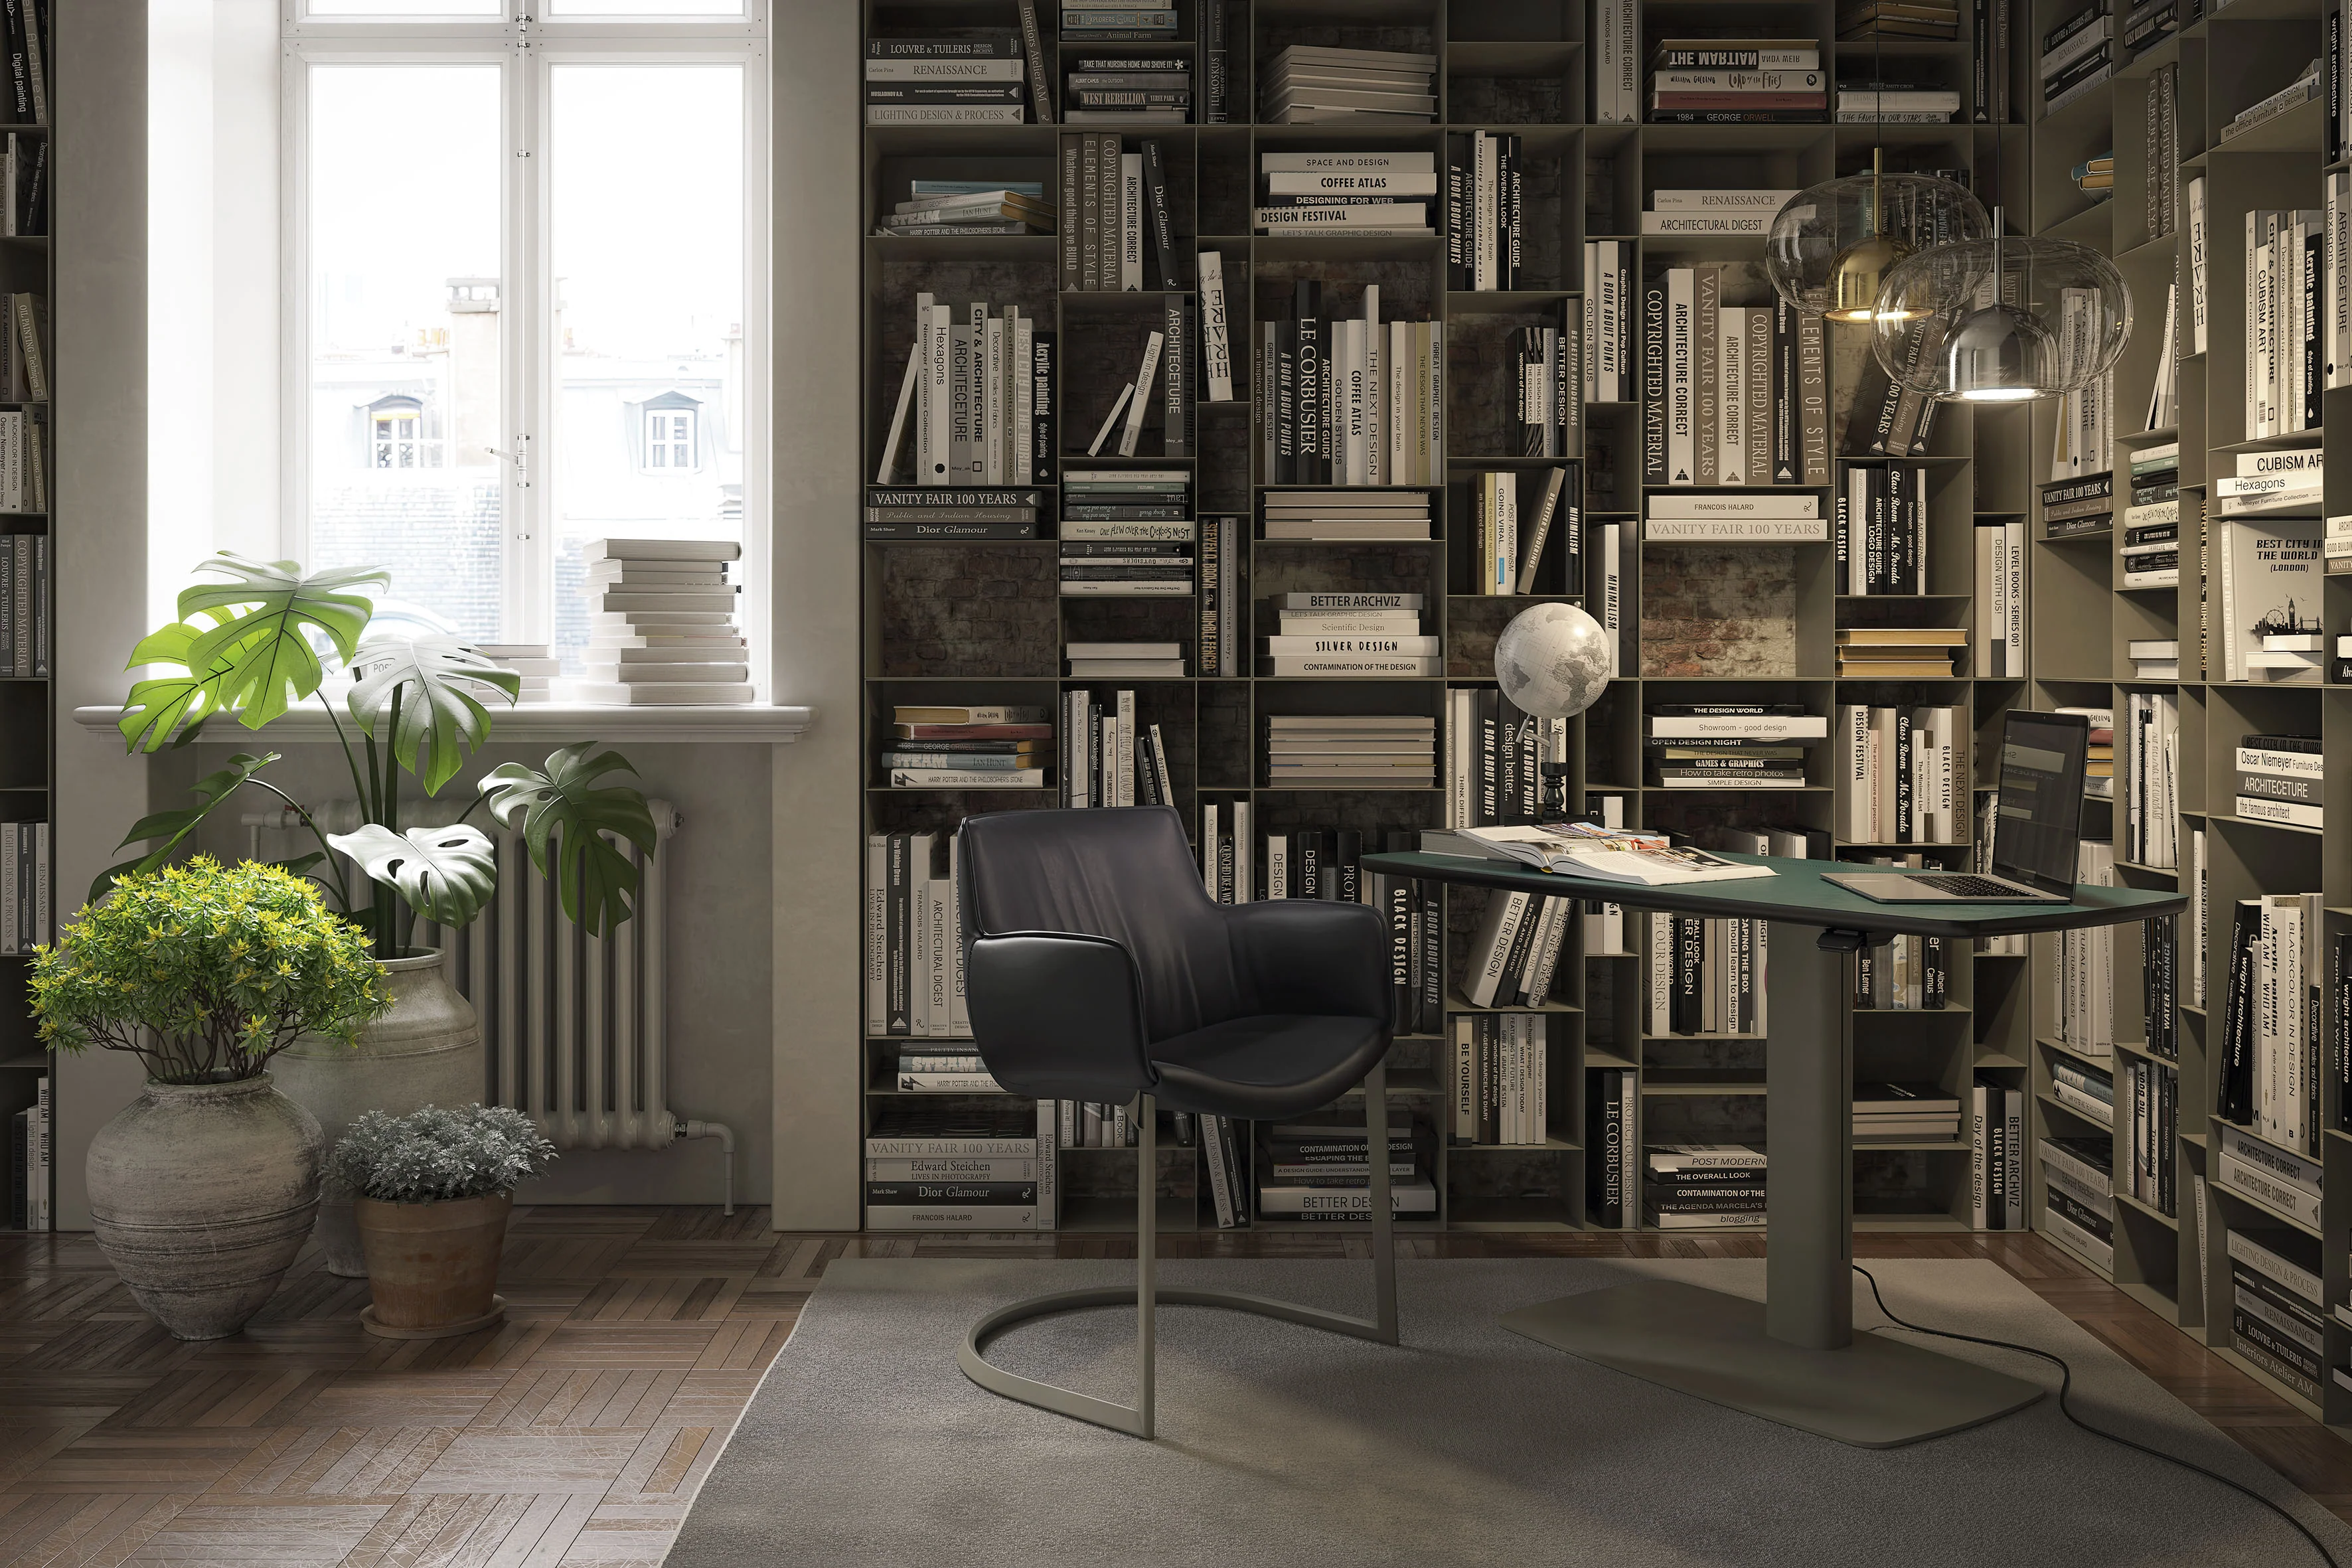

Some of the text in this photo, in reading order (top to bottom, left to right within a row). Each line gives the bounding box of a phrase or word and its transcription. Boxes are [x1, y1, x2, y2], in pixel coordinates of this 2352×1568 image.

[890, 44, 925, 54] LOUVRE
[933, 44, 971, 54] TUILERIS
[913, 65, 987, 75] RENAISSANCE
[1107, 60, 1127, 68] NURSING
[875, 110, 1004, 120] LIGHTING DESIGN & PROCESS
[1082, 92, 1146, 105] WEST REBELLION
[1320, 177, 1387, 188] COFFEE ATLAS
[1702, 195, 1776, 205] RENAISSANCE
[1085, 141, 1096, 285] ELEMENTS OF STYLE
[1127, 176, 1137, 264] ARCHITECTURE CORRECT
[1155, 185, 1170, 250] Dior Glamour
[1261, 209, 1347, 223] DESIGN FESTIVAL
[1660, 219, 1763, 230] ARCHITECTURAL DIGEST
[2258, 270, 2266, 324] CUBISM
[19, 305, 39, 388] OIL PAINTING Techniques
[933, 327, 947, 385] Hexagons
[1168, 309, 1180, 414] ARCHITECETURE
[955, 339, 967, 442] ARCHITECETURE
[974, 309, 983, 442] CITY & ARCHITECTURE
[1300, 317, 1316, 455] LE CORBUSIER
[1647, 290, 1663, 475] COPYRIGHTED MATERIAL
[1676, 303, 1687, 437] ARCHITECTURE CORRECT
[1726, 336, 1739, 445] ARCHITECTURE CORRECT
[1351, 370, 1362, 435] COFFEE ATLAS
[1369, 423, 1377, 475] DESIGN
[875, 493, 1016, 505] VANITY FAIR 100 YEARS
[2235, 477, 2285, 491] Hexagons
[1569, 507, 1579, 554] MINIMALISM
[1837, 497, 1847, 561] BLACK DESIGN
[2256, 539, 2283, 548] BEST
[2285, 539, 2310, 548] CITY
[2257, 551, 2318, 560] THE WORLD
[2270, 564, 2309, 573] (LONDON)
[17, 540, 27, 670] COPYRIGHTED MATERIAL
[1310, 595, 1401, 607] BETTER ARCHVIZ
[1607, 574, 1617, 629] MINIMALISM
[2011, 571, 2019, 599] BOOKS
[1359, 623, 1385, 632] Design
[2011, 605, 2019, 631] SERIES
[1315, 641, 1397, 652] SILVER DESIGN
[2011, 633, 2019, 647] 001
[1855, 712, 1864, 781] DESIGN FESTIVAL
[2241, 751, 2313, 771] Oscar Niemeyer Furniture
[1942, 745, 1950, 809] BLACK DESIGN
[2244, 777, 2308, 797] ARCHITECETURE
[1273, 853, 1283, 896] DESIGN
[1305, 850, 1316, 894] DESIGN
[933, 900, 943, 1008] ARCHITECTURAL DIGEST
[1393, 889, 1407, 984] BLACK DESIGN
[1862, 959, 1871, 994] Ben Lerner
[2289, 1024, 2295, 1038] IN
[1460, 1044, 1470, 1115] BE YOURSELF
[911, 1160, 990, 1171] Edward Steichen
[1607, 1101, 1619, 1206] LE CORBUSIER
[2009, 1117, 2019, 1208] BETTER ARCHVIZ
[2237, 1140, 2300, 1181] ARCHITECTURE CORRECT
[918, 1186, 990, 1197] Dior Glamour
[2264, 1306, 2315, 1346] RENAISSANCE
